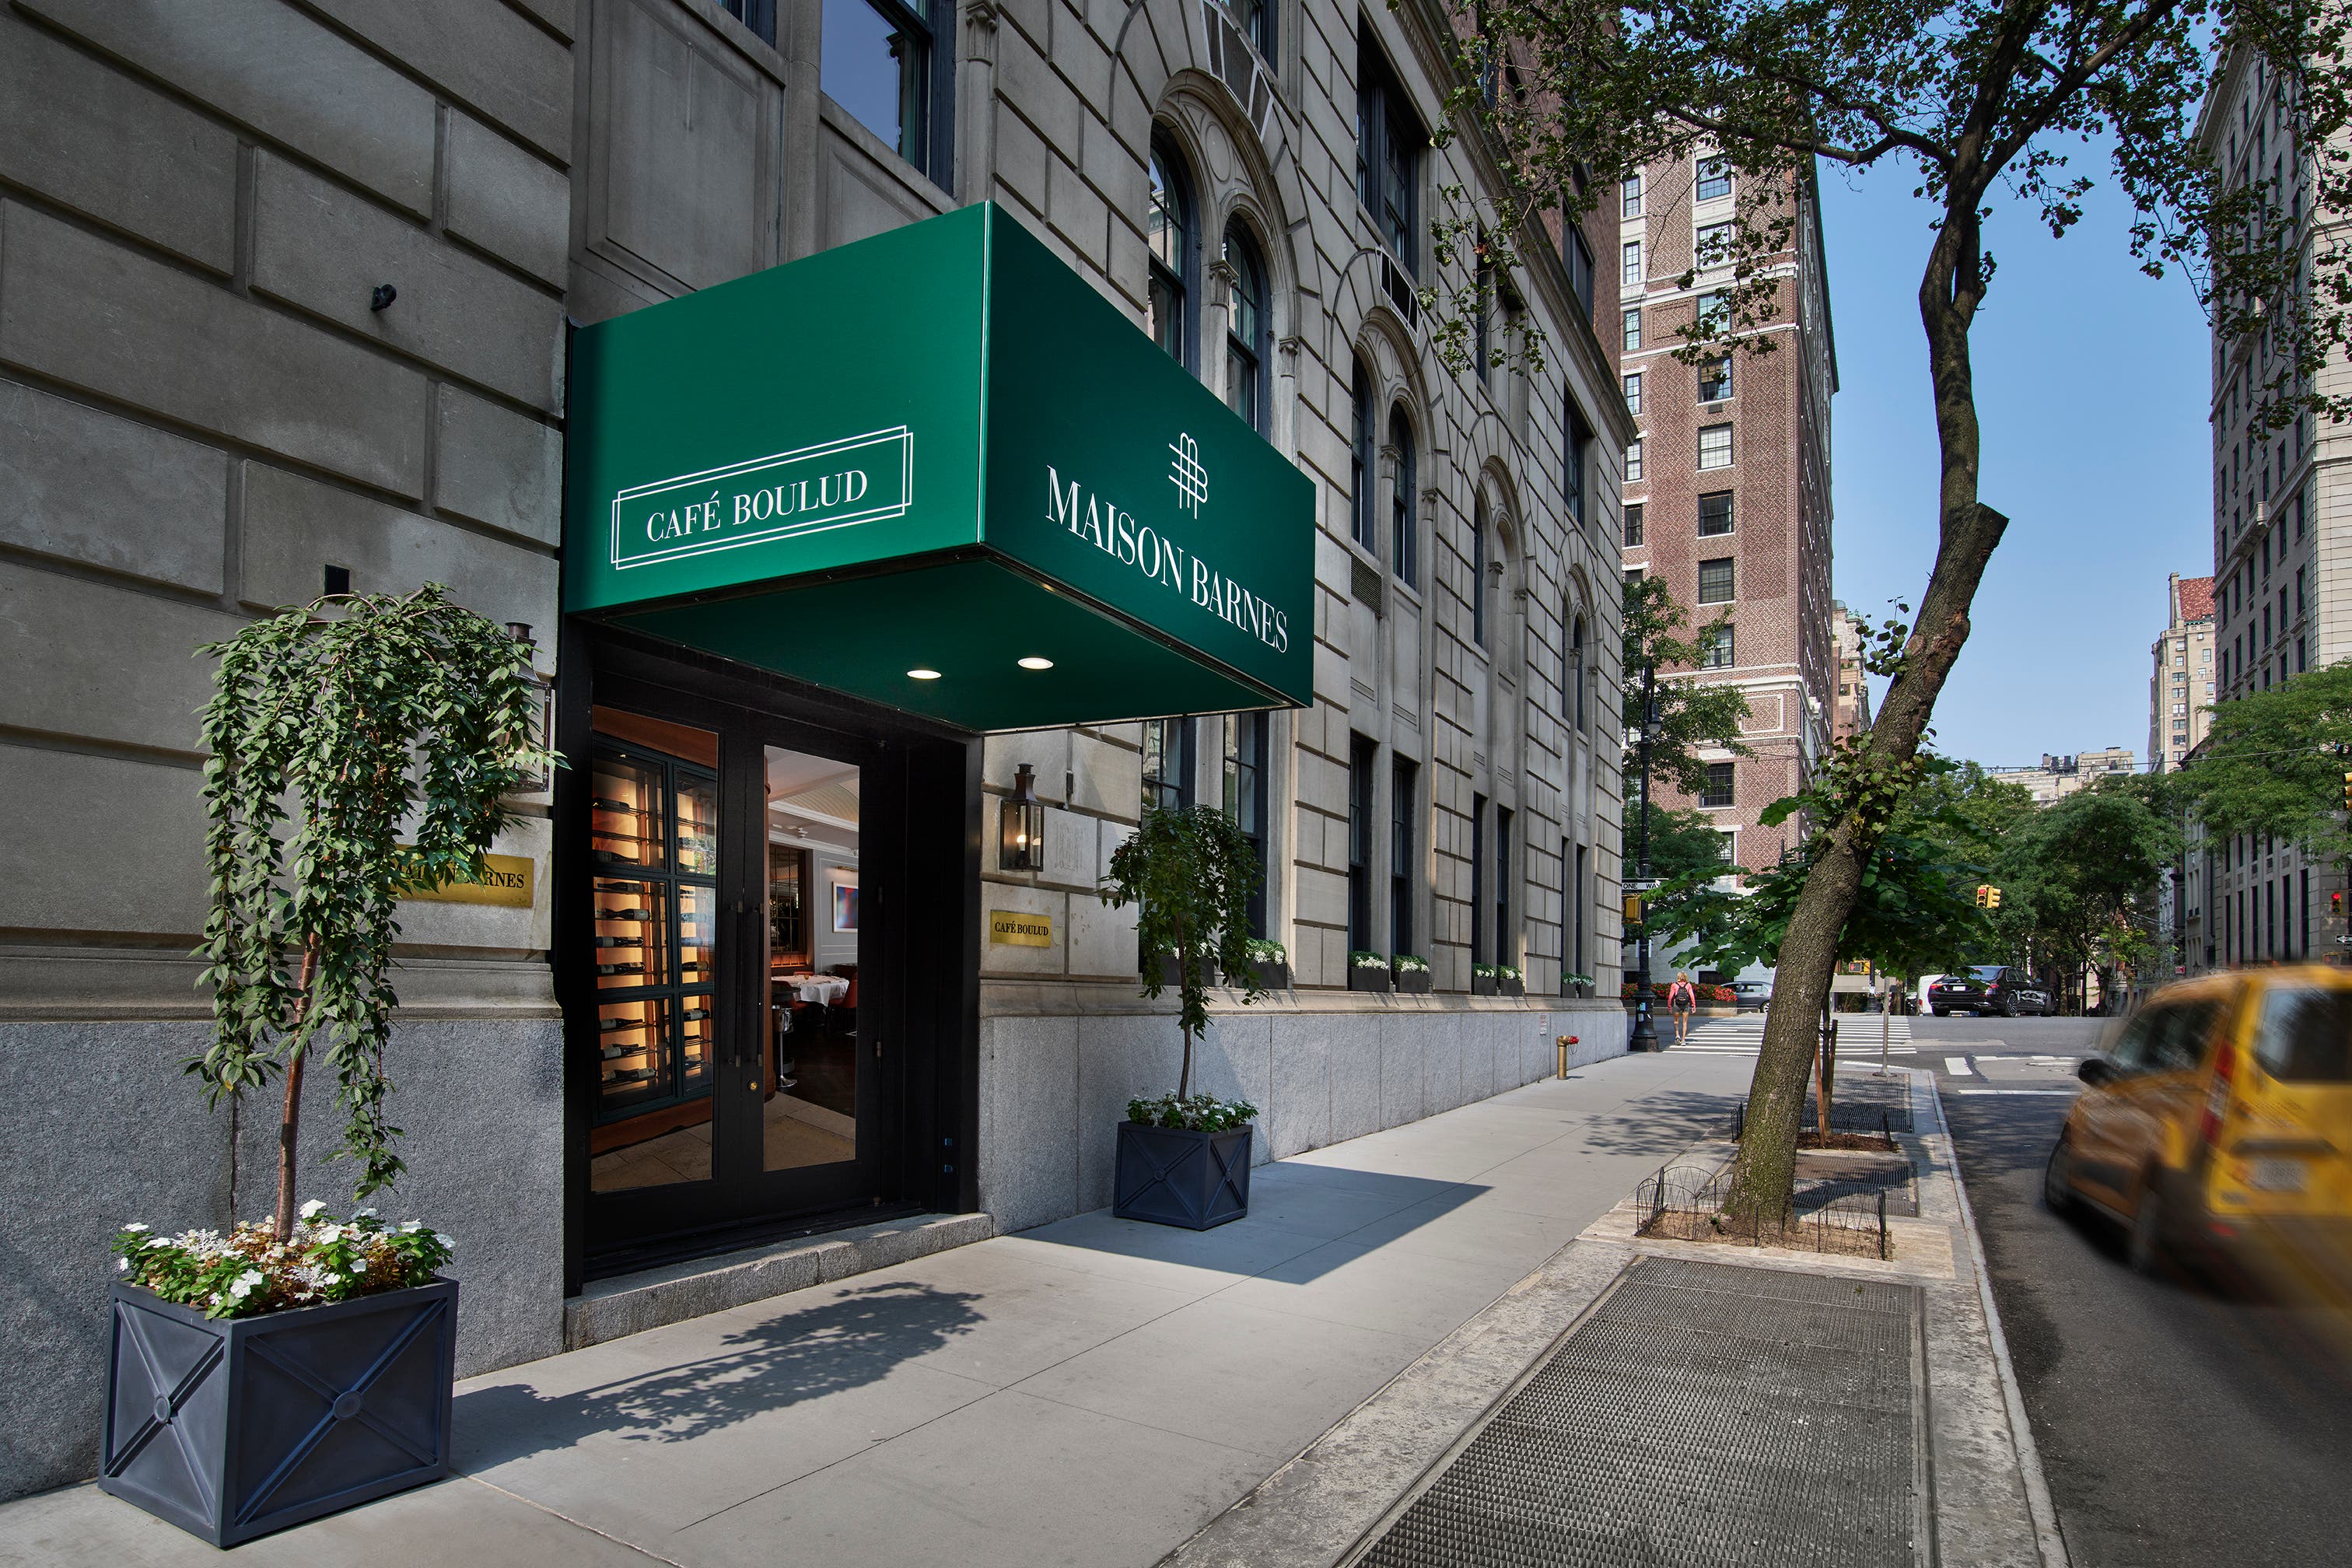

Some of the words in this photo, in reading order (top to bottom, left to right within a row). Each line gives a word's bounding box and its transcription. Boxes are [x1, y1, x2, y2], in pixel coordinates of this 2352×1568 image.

[646, 490, 721, 542] CAFÉ
[733, 470, 868, 526] BOULUD
[1046, 464, 1184, 593] MAISON
[1191, 555, 1288, 653] BARNES
[463, 868, 525, 889] RNES
[995, 921, 1016, 933] CAFÉ
[1017, 924, 1048, 936] BOULUD
